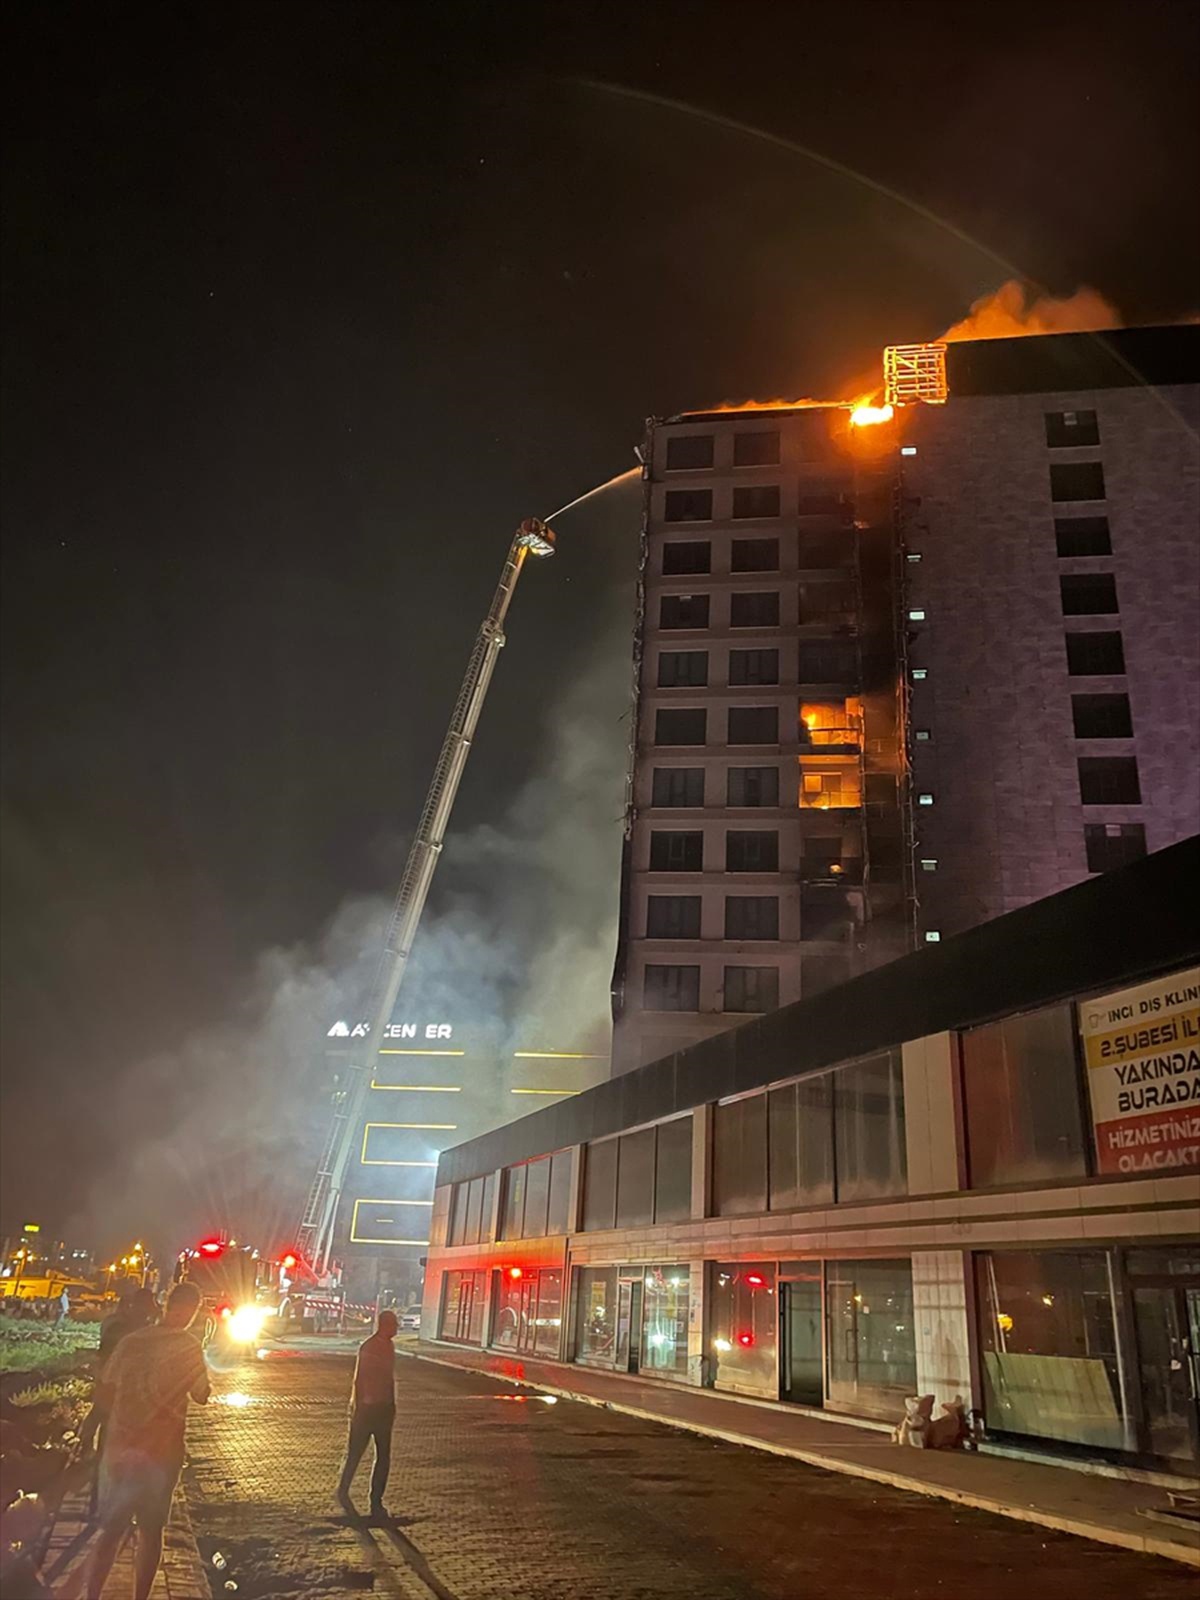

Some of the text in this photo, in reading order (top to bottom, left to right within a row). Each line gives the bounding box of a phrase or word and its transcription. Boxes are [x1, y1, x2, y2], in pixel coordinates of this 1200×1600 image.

[1100, 1015, 1200, 1059] 2.ŞUBESİ İL
[1114, 1049, 1200, 1086] YAKINDA
[1118, 1077, 1200, 1113] BURADA
